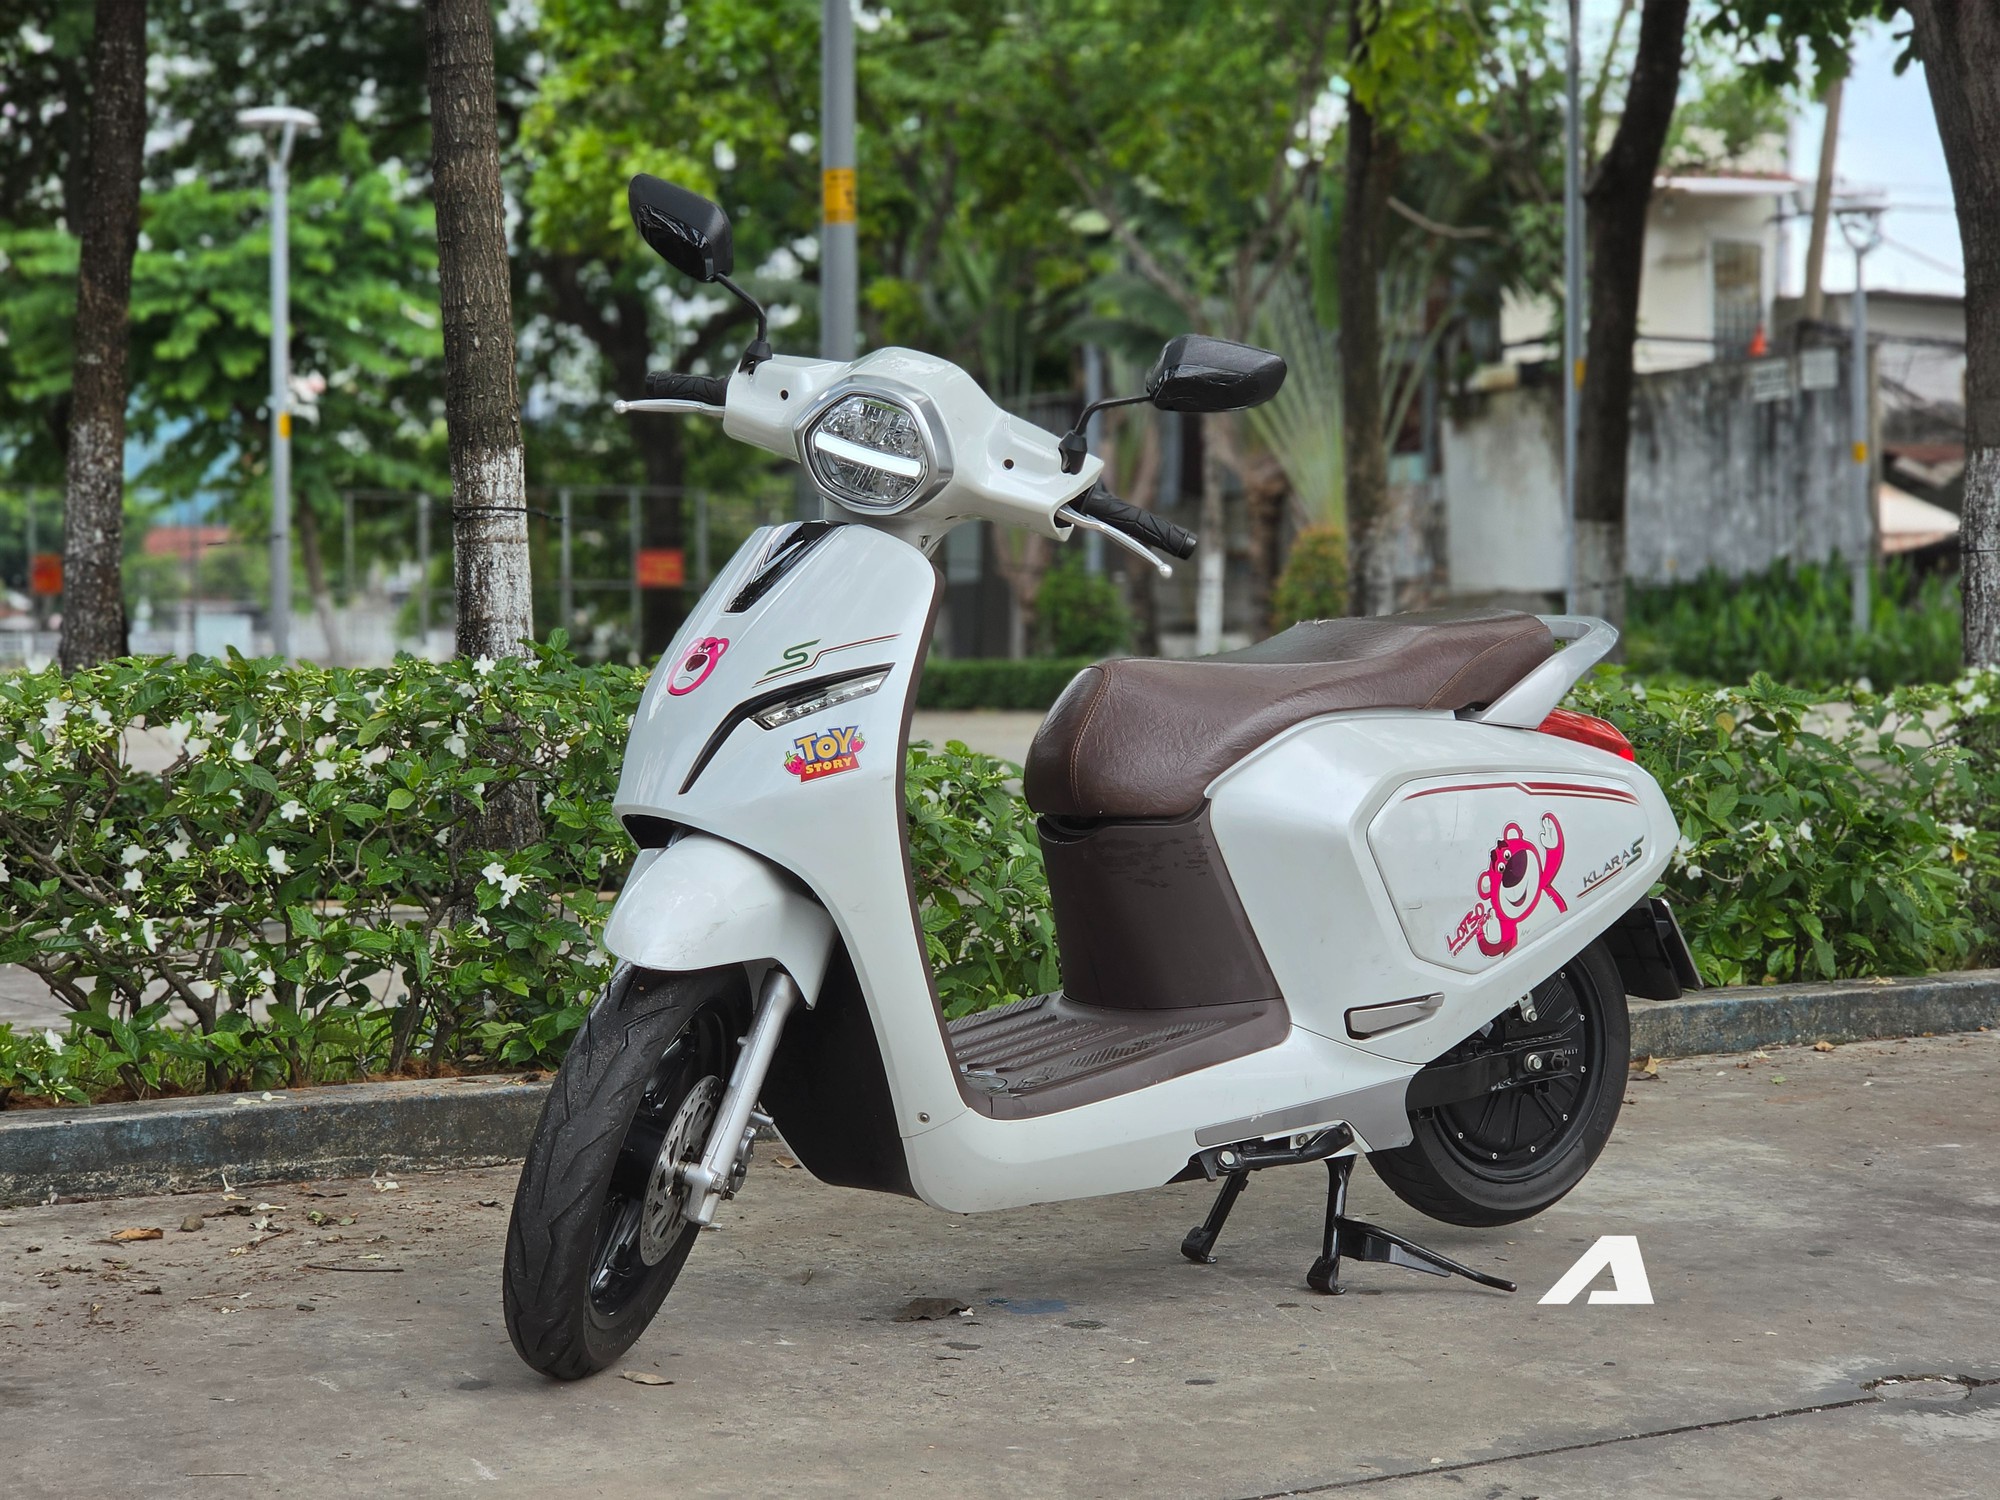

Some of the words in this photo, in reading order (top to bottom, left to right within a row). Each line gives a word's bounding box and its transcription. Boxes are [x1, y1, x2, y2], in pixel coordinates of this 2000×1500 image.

[763, 638, 821, 676] S
[805, 757, 852, 774] STORY
[1582, 849, 1631, 888] KLARA
[1446, 902, 1485, 952] LOTSO
